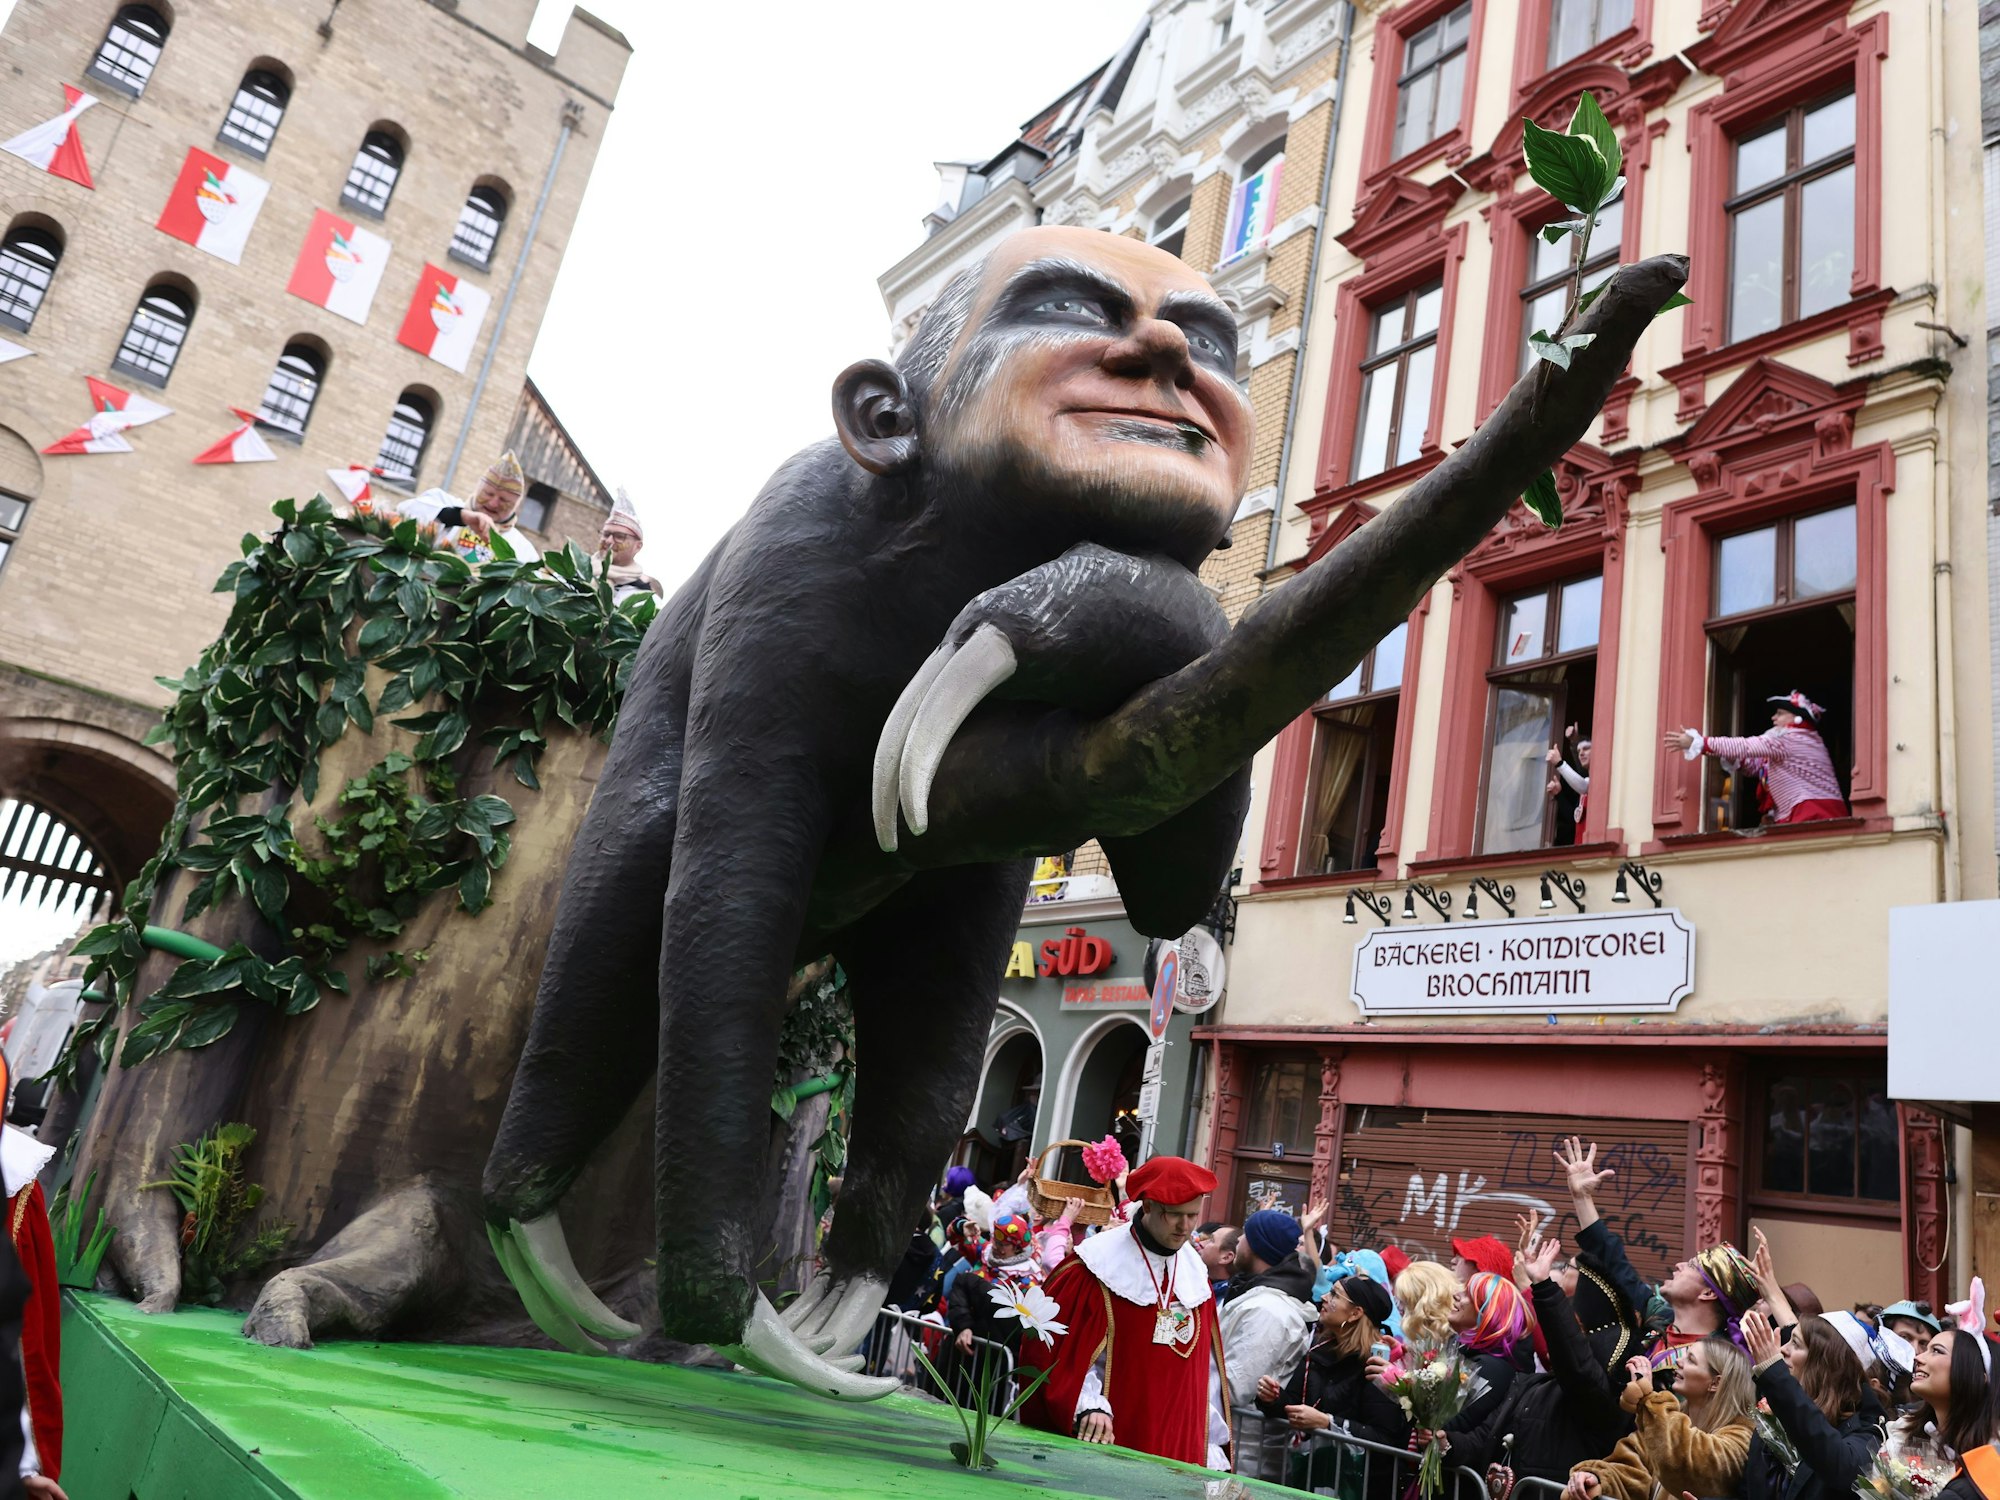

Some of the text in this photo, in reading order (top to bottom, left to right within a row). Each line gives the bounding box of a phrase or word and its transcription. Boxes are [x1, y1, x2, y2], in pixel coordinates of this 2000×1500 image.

[1038, 927, 1113, 978] SÜD
[1374, 931, 1665, 967] BÄCKEREI KONDITOREI
[1427, 969, 1591, 998] BROCHMANN
[1274, 1144, 1281, 1157] 5
